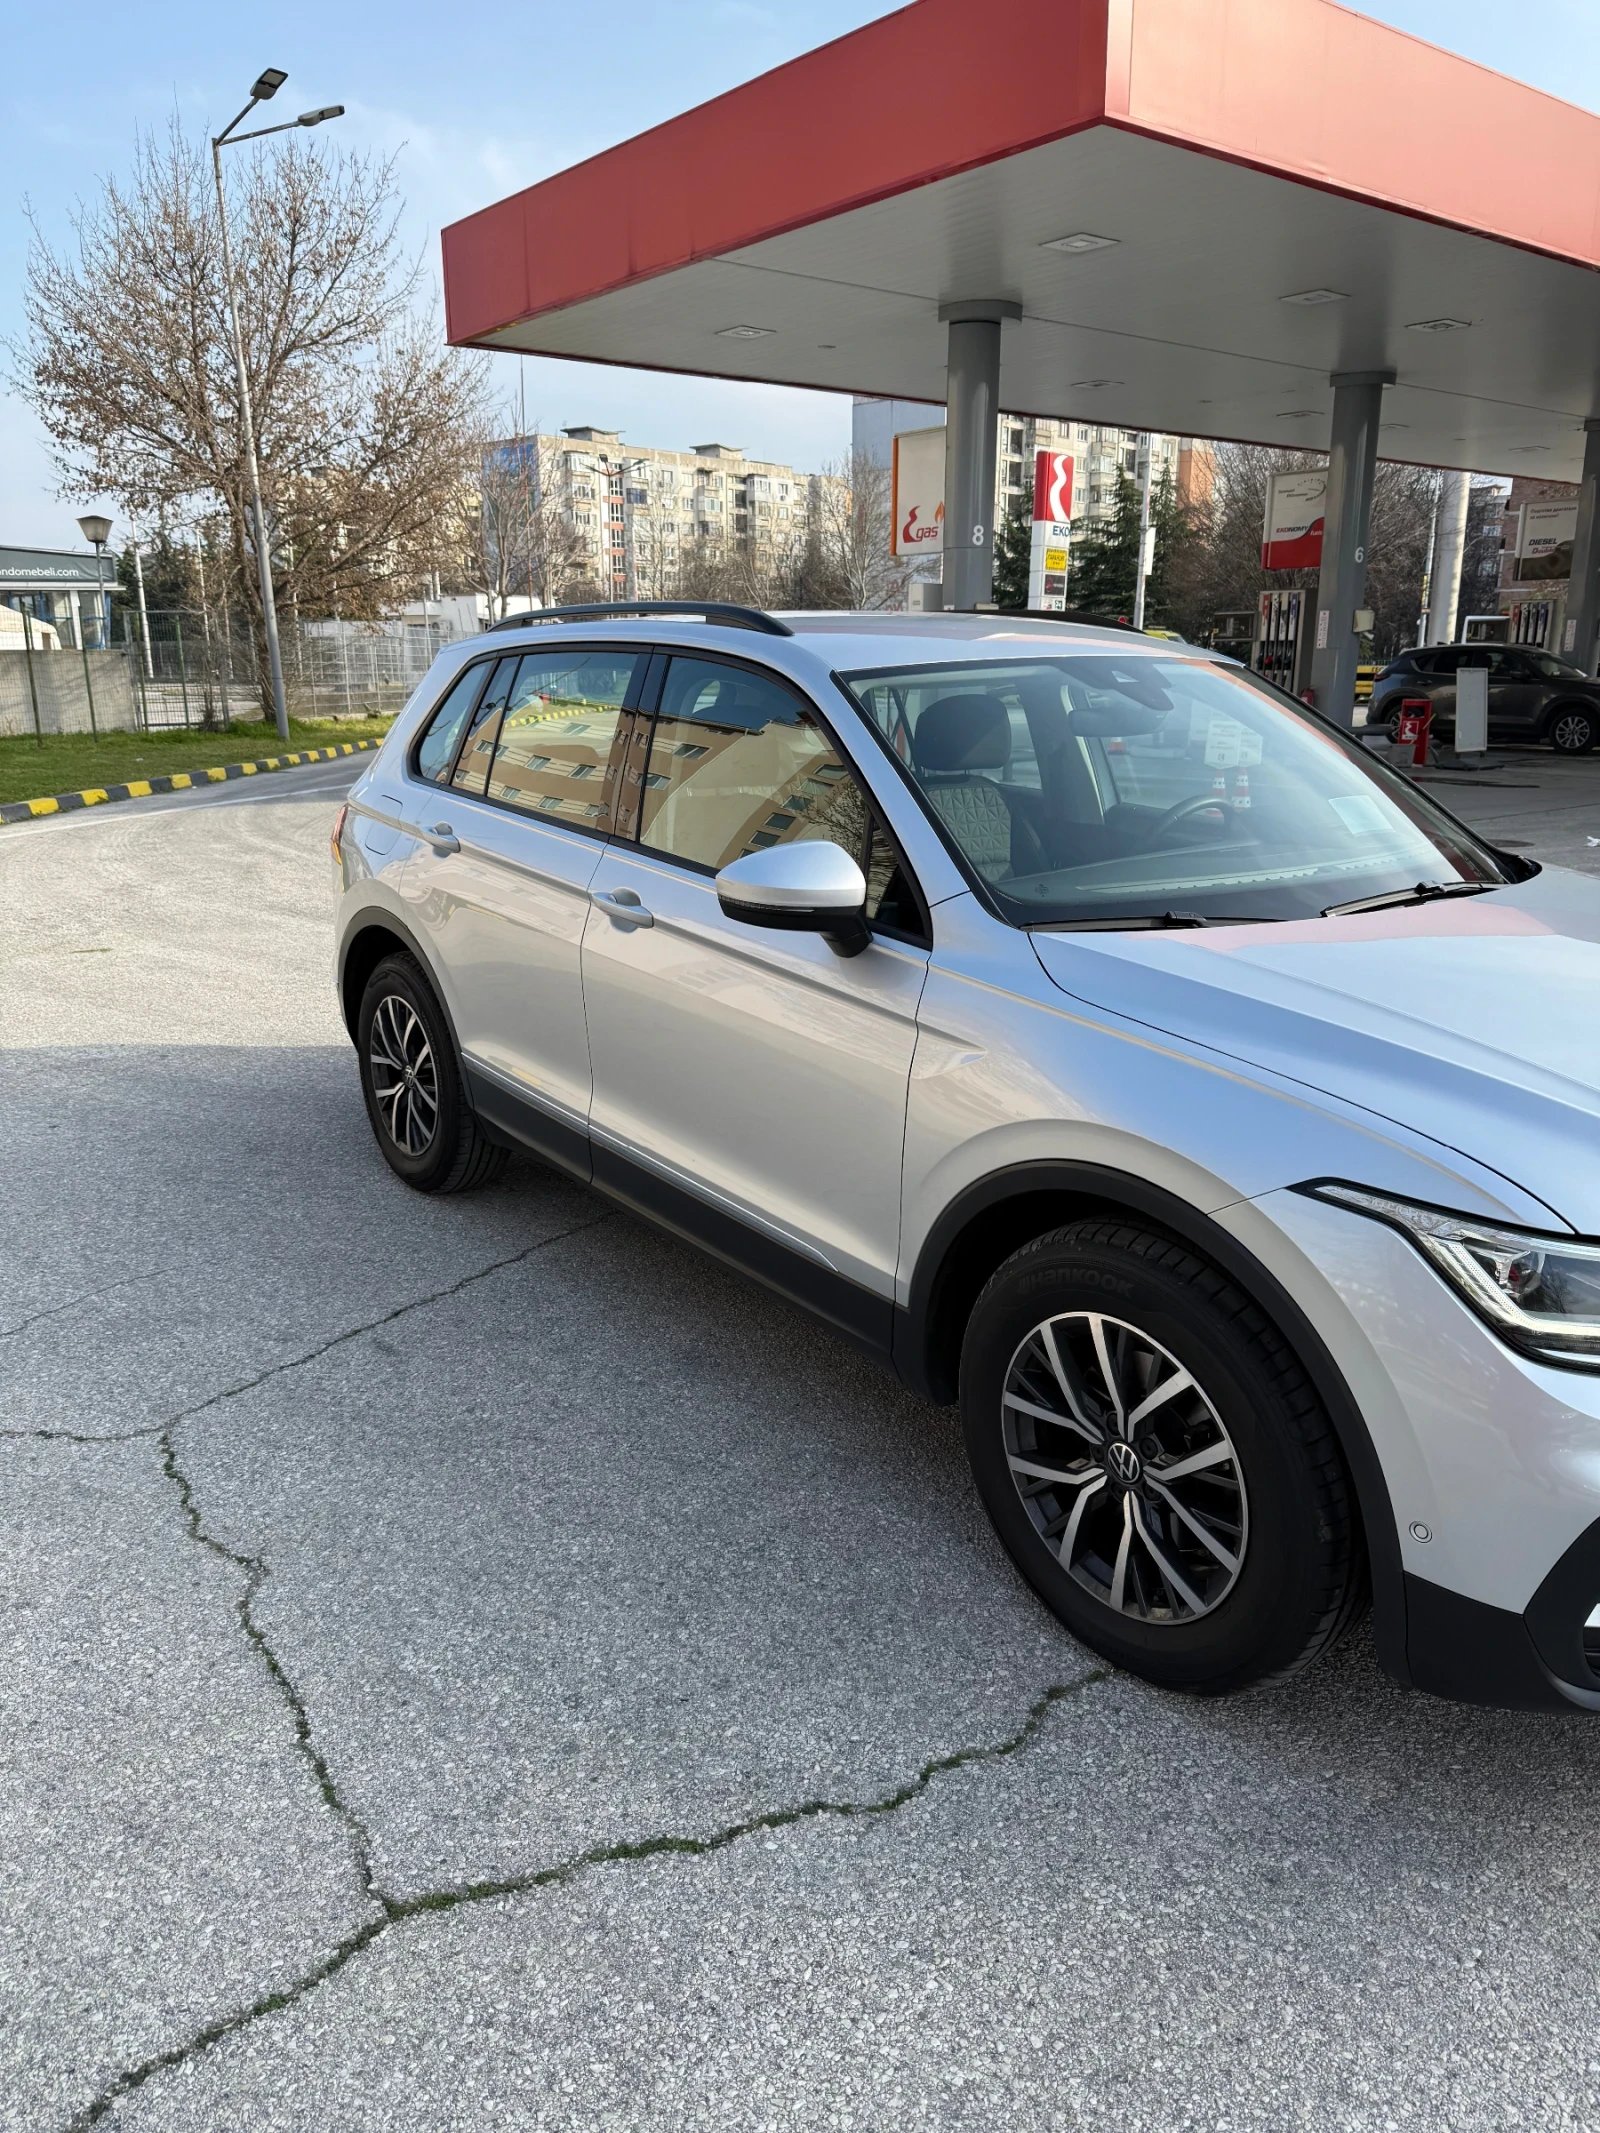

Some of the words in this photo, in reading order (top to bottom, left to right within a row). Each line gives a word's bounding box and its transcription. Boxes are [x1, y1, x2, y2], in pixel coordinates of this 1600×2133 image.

[916, 526, 939, 542] gas
[972, 525, 984, 545] 8
[1528, 538, 1557, 546] DIESEL
[1354, 546, 1364, 563] 6
